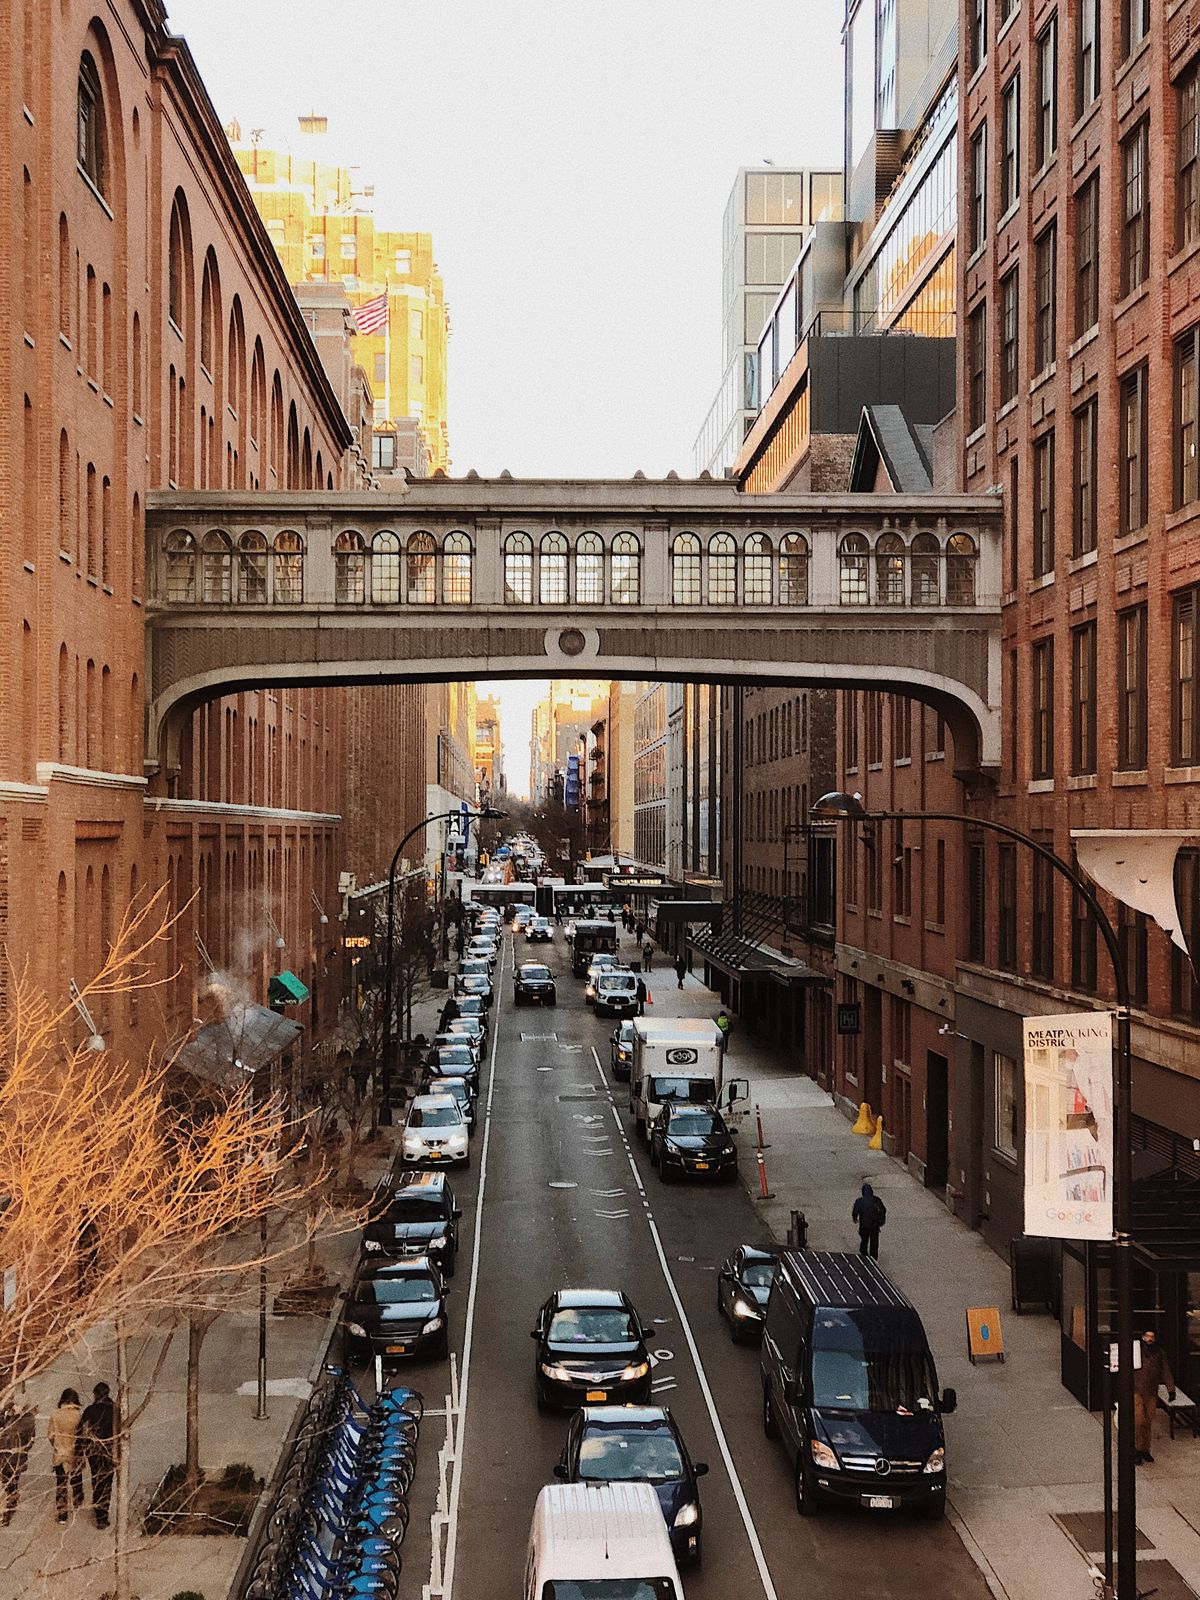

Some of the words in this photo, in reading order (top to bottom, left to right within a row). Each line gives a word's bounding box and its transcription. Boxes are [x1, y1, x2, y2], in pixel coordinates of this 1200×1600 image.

[1028, 1028, 1108, 1039] MEATPACKING
[1028, 1039, 1075, 1047] DISTRICT
[1046, 1208, 1092, 1225] Google
